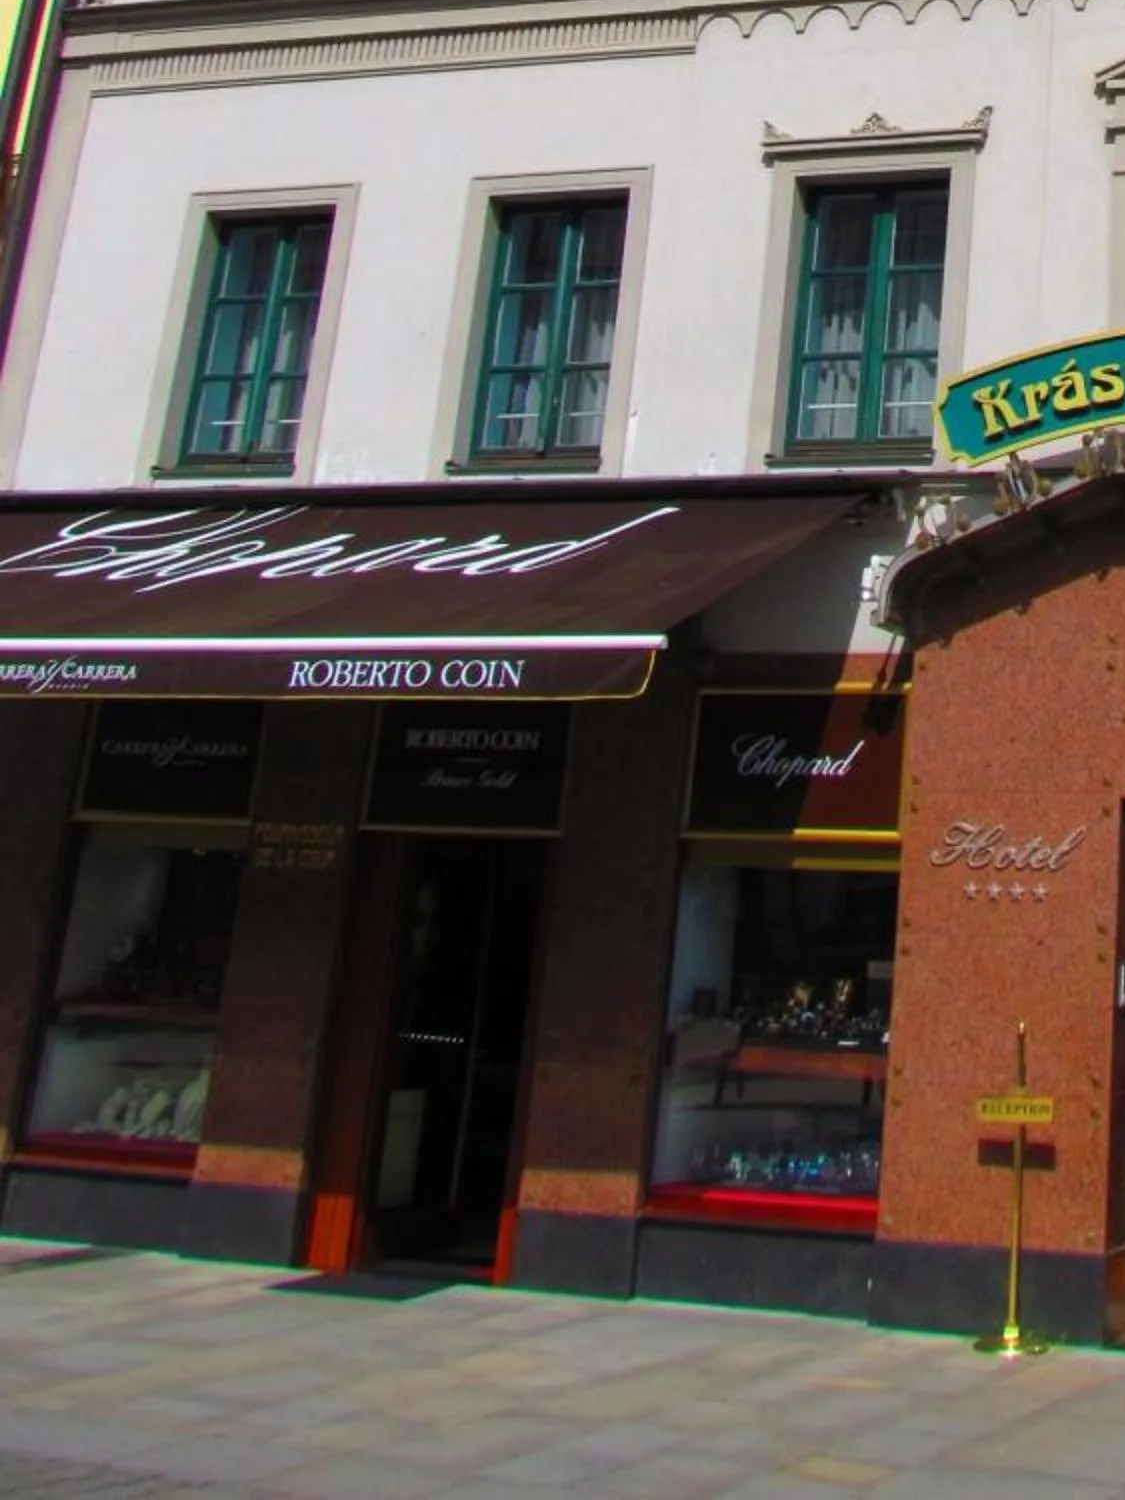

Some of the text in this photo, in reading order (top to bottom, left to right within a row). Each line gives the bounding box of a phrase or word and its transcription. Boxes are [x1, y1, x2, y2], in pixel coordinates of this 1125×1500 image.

[287, 659, 526, 689] ROBERTO COIN
[731, 731, 866, 790] Chopard
[929, 821, 1087, 873] Hotel
